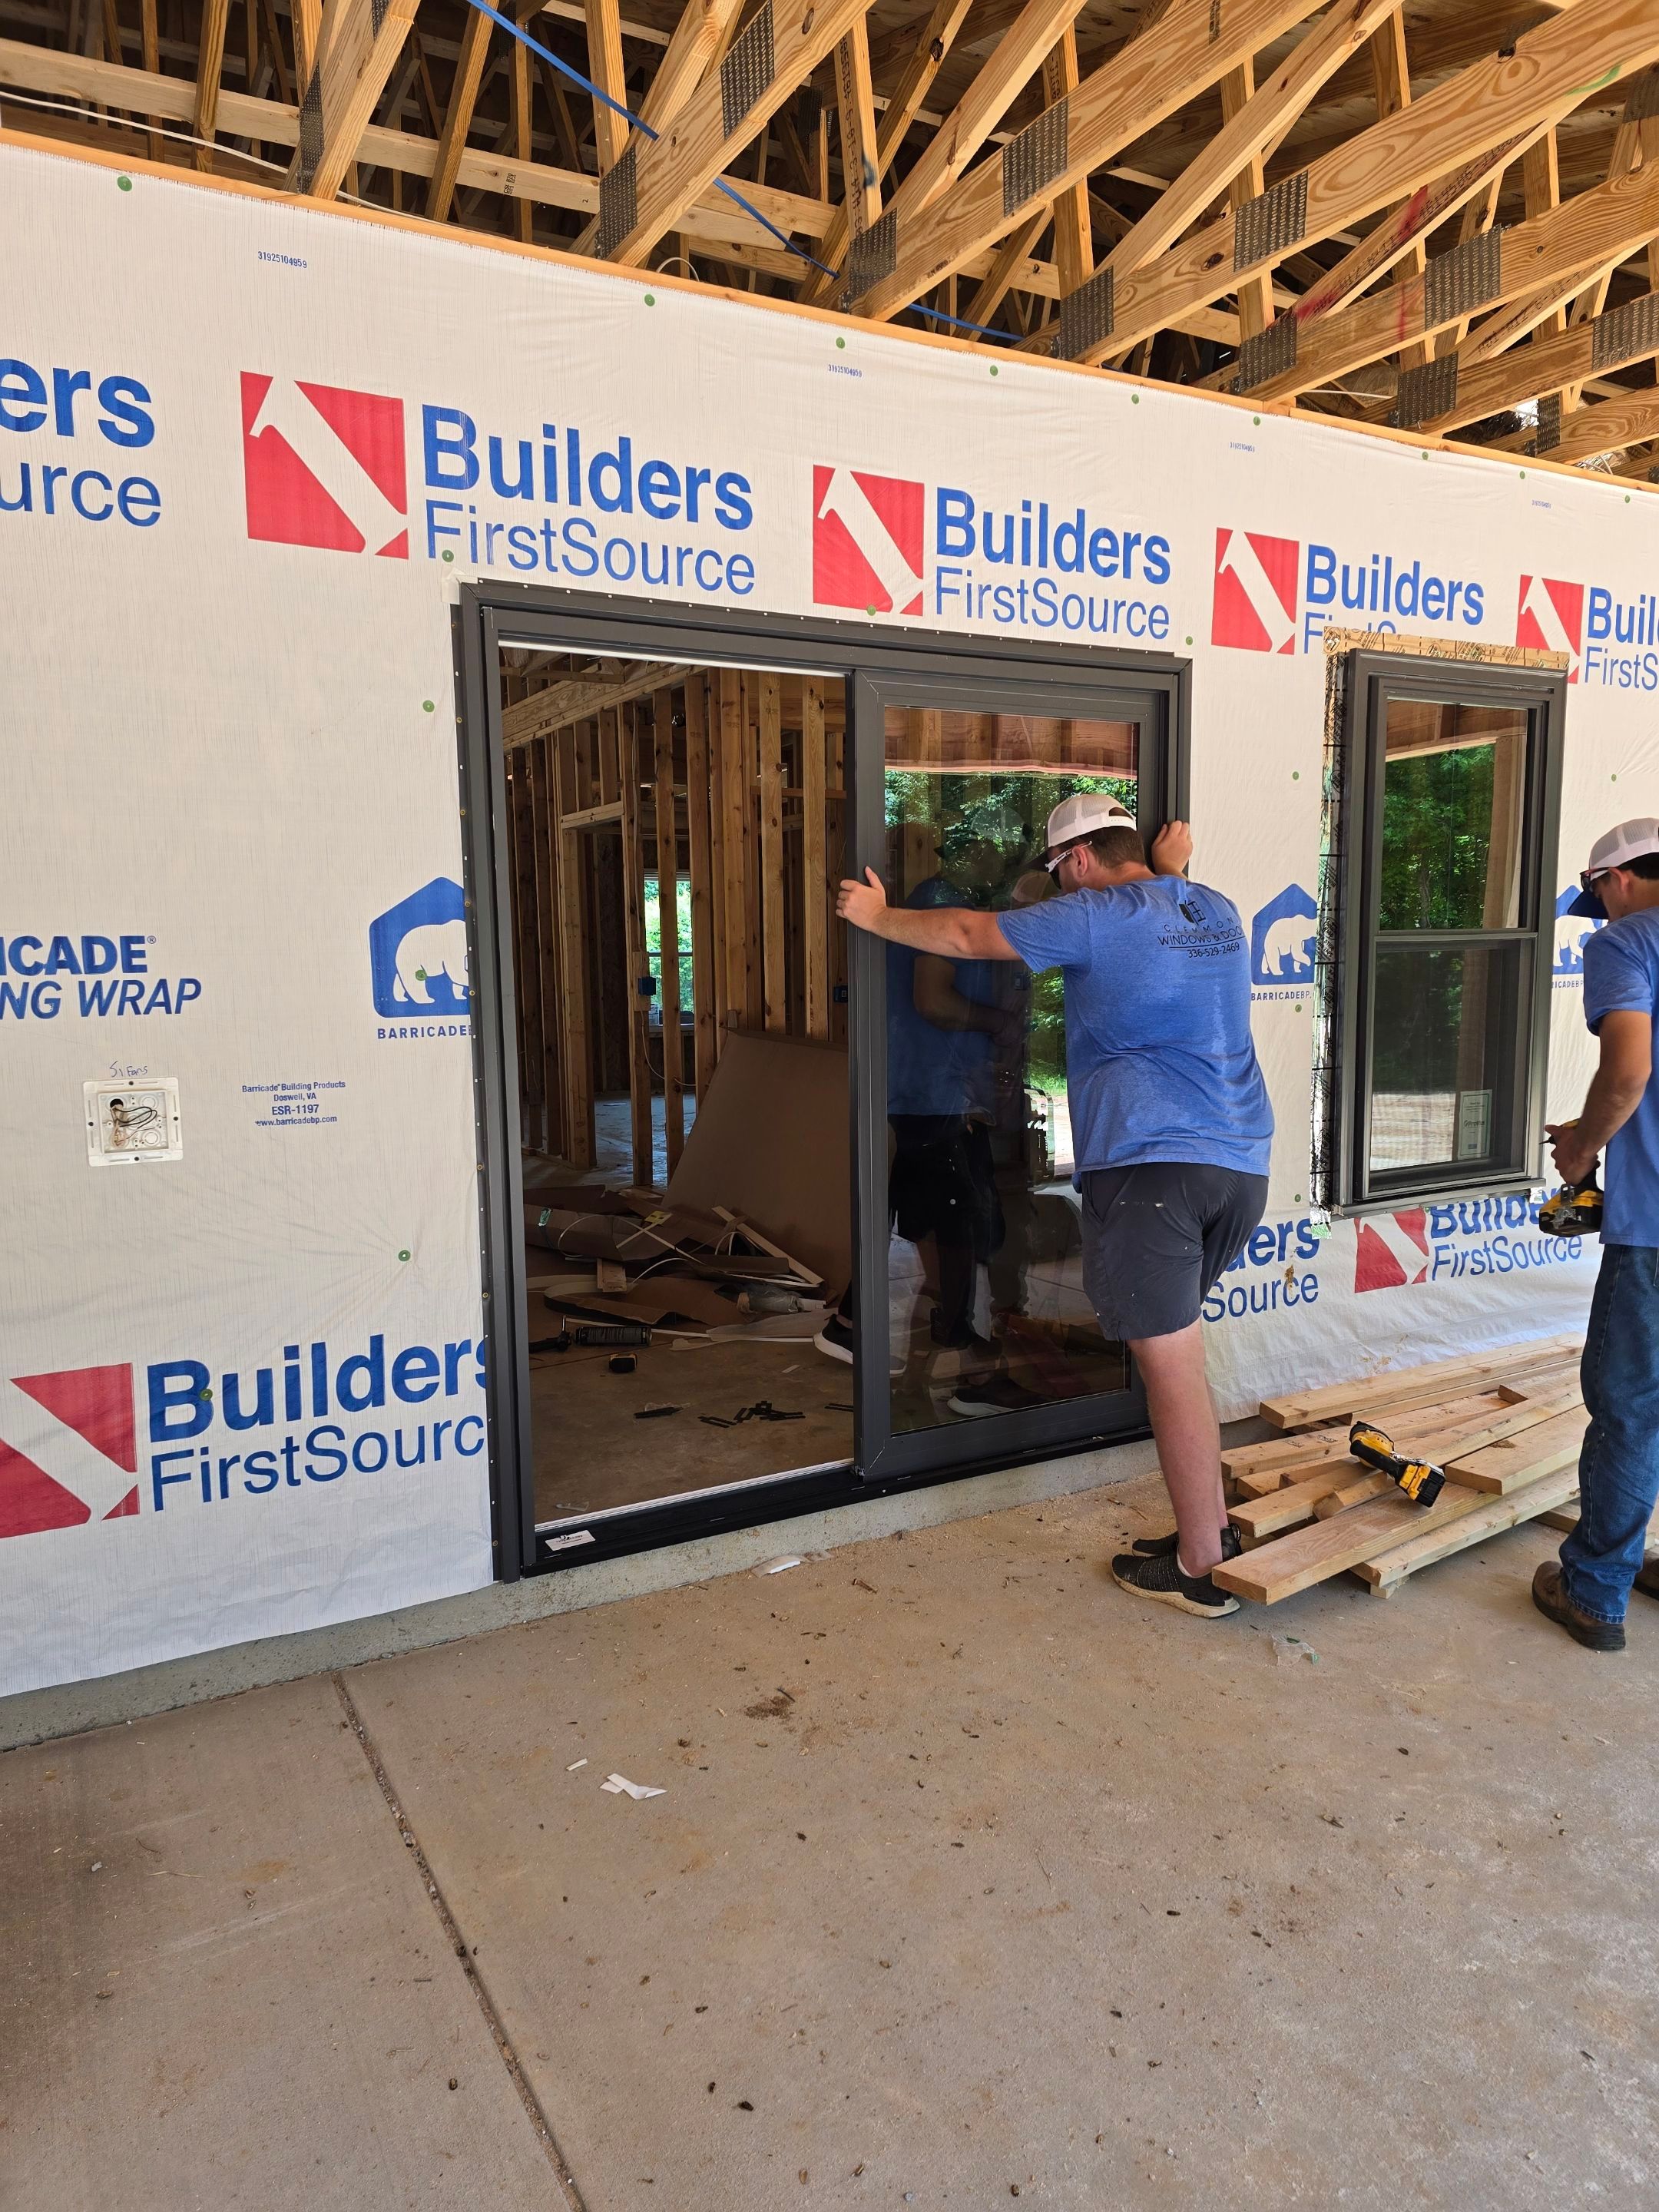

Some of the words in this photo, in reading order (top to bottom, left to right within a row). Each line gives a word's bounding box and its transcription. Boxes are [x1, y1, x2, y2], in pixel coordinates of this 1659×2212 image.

[258, 250, 307, 269] 31925104959
[422, 404, 753, 531] Builders
[426, 498, 755, 595] FirstSource
[936, 486, 1171, 584] Builders
[936, 566, 1170, 641] FirstSource
[1306, 543, 1485, 626] Builders
[1587, 586, 1659, 646] Buil
[1157, 934, 1212, 945] WINDOWS
[1187, 942, 1240, 959] 336-529-2469
[78, 978, 202, 1017] WRAP
[272, 1104, 320, 1116] ESR-1197
[273, 1093, 306, 1101] Doswell,
[281, 1082, 312, 1091] Building
[313, 1081, 346, 1089] Products
[1432, 1234, 1583, 1281] FirstSource
[147, 1334, 487, 1443] Builder
[151, 1415, 485, 1512] FirstSourc
